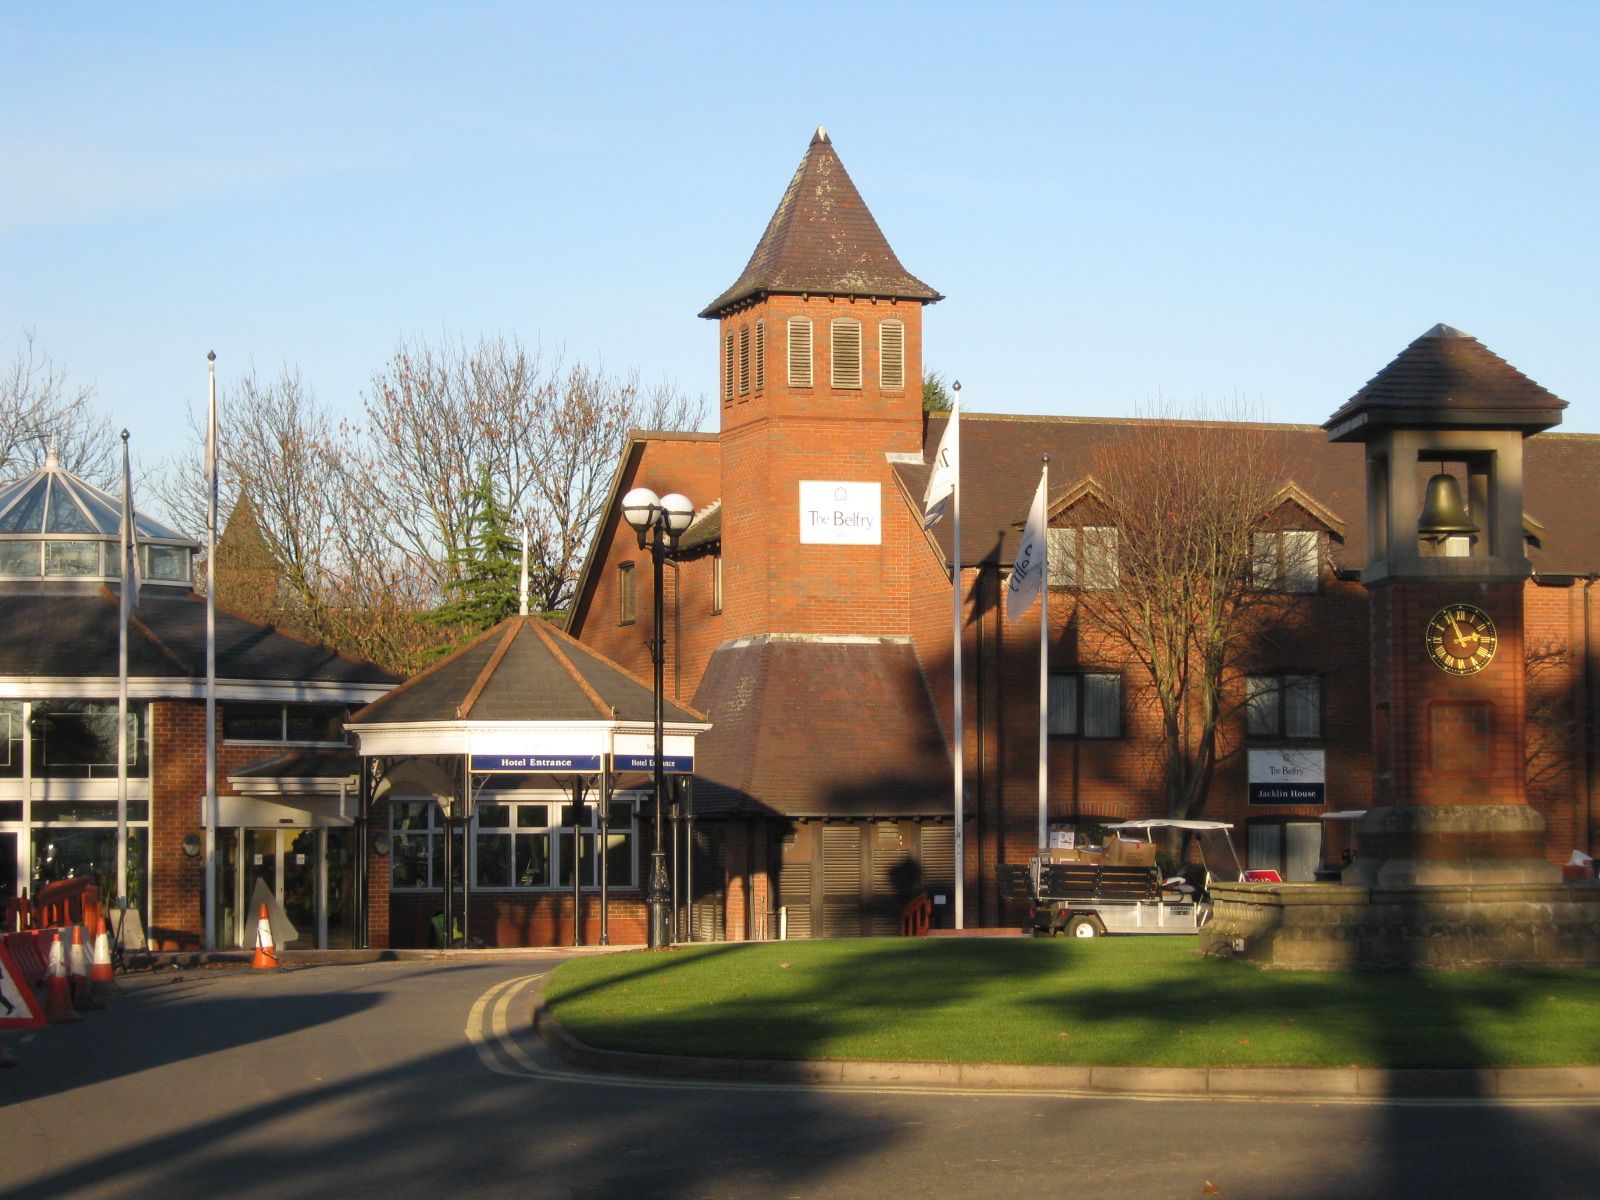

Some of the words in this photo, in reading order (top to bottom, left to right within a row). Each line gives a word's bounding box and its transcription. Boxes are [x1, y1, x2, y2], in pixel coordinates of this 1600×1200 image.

[808, 510, 829, 526] The
[833, 510, 873, 531] Belfry
[501, 758, 526, 767] Hotel
[530, 758, 572, 767] Entrance
[631, 758, 648, 767] Hotel
[1269, 766, 1281, 776] The
[1282, 766, 1304, 776] Belfry
[1258, 789, 1288, 798] Jacklin
[1290, 789, 1317, 798] House
